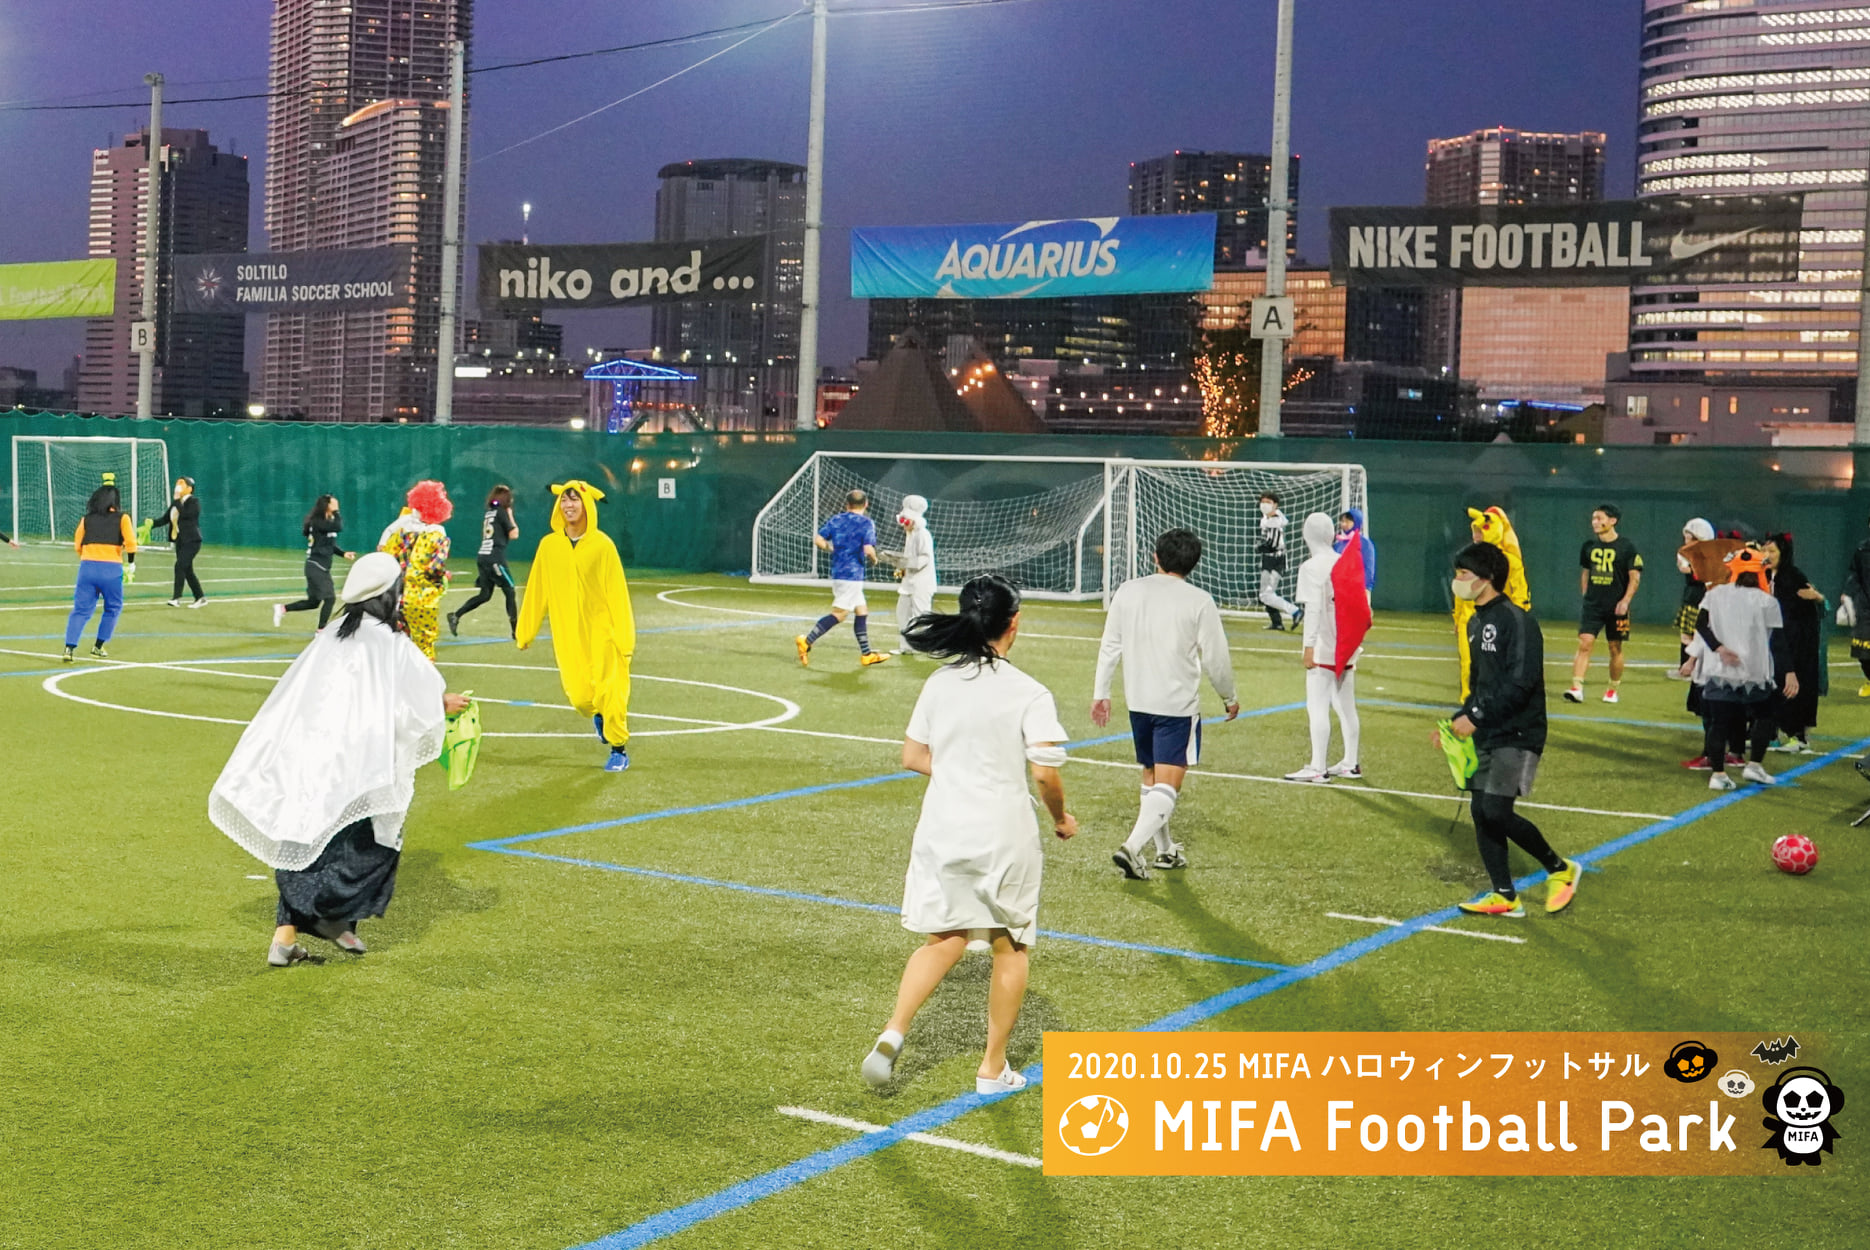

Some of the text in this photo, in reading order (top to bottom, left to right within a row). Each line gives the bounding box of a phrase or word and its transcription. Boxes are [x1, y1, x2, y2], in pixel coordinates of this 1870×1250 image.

[1349, 221, 1652, 269] NIKE FOOTBALL
[935, 238, 1120, 280] AQUARIUS
[236, 263, 288, 281] SOLTILO
[499, 256, 593, 300] niko
[610, 250, 702, 299] and
[236, 281, 394, 302] FAMILIA SOCCER SCHOOL
[1262, 305, 1283, 330] A
[138, 328, 147, 346] B
[663, 482, 671, 495] B
[1590, 547, 1616, 573] SR
